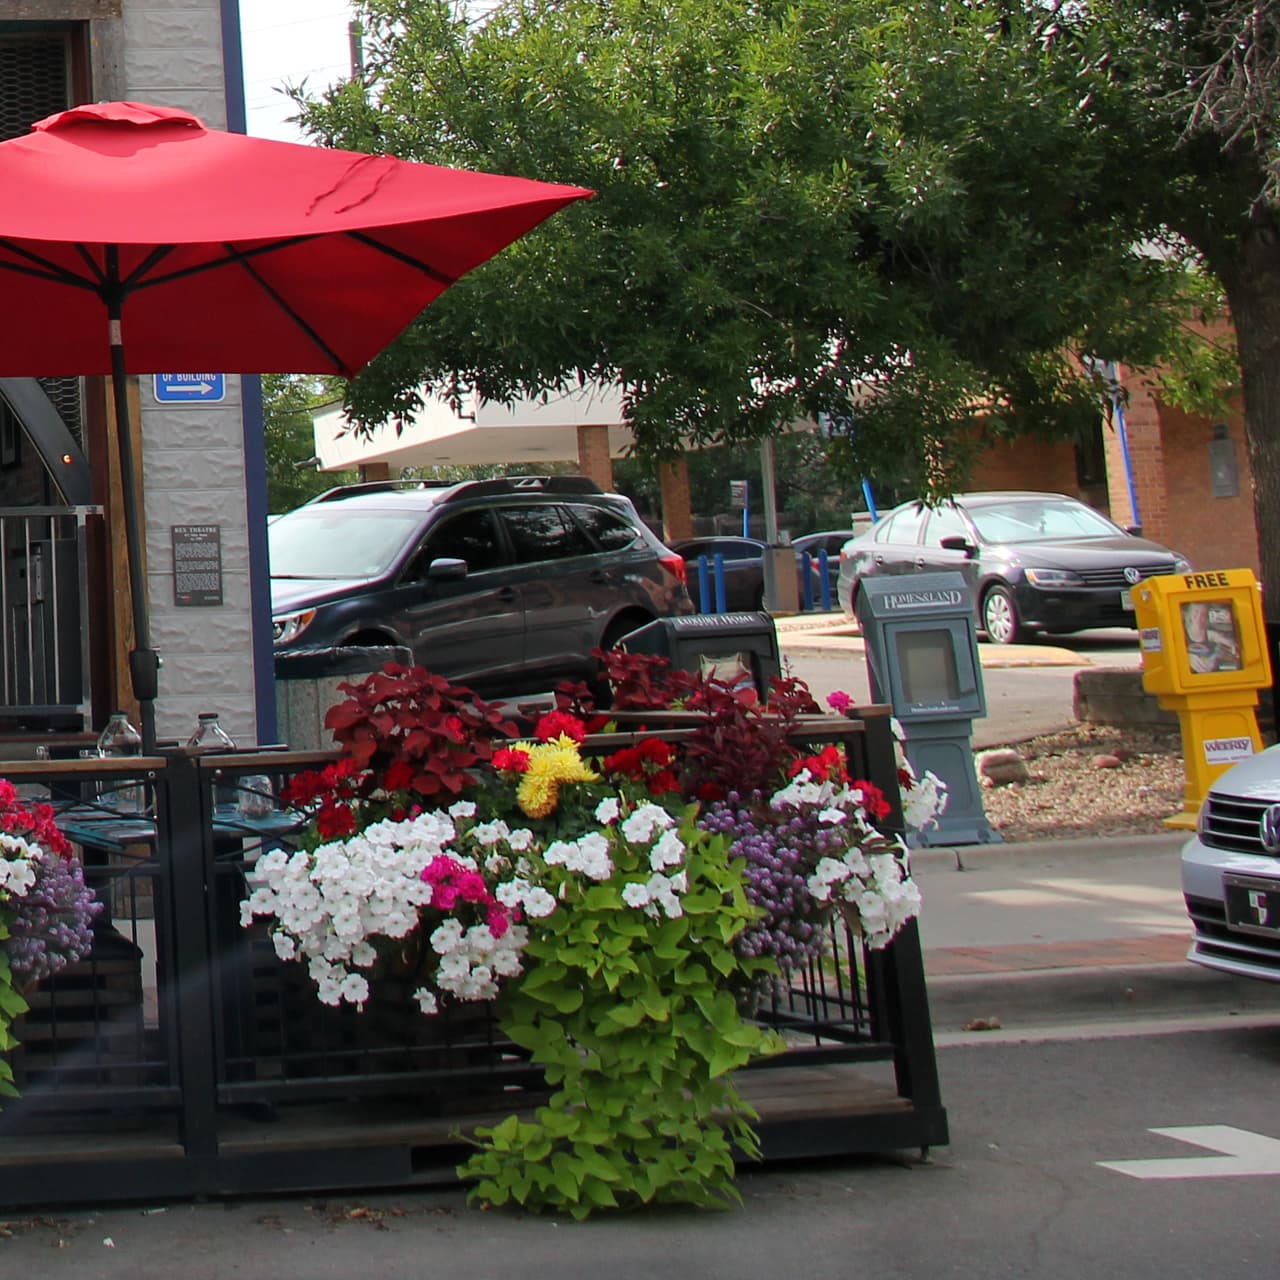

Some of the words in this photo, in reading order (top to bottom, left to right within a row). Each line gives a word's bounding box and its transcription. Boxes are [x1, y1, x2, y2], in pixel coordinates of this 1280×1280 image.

[1184, 573, 1230, 590] FREE
[678, 615, 719, 626] LUXURY
[721, 615, 754, 624] HOME
